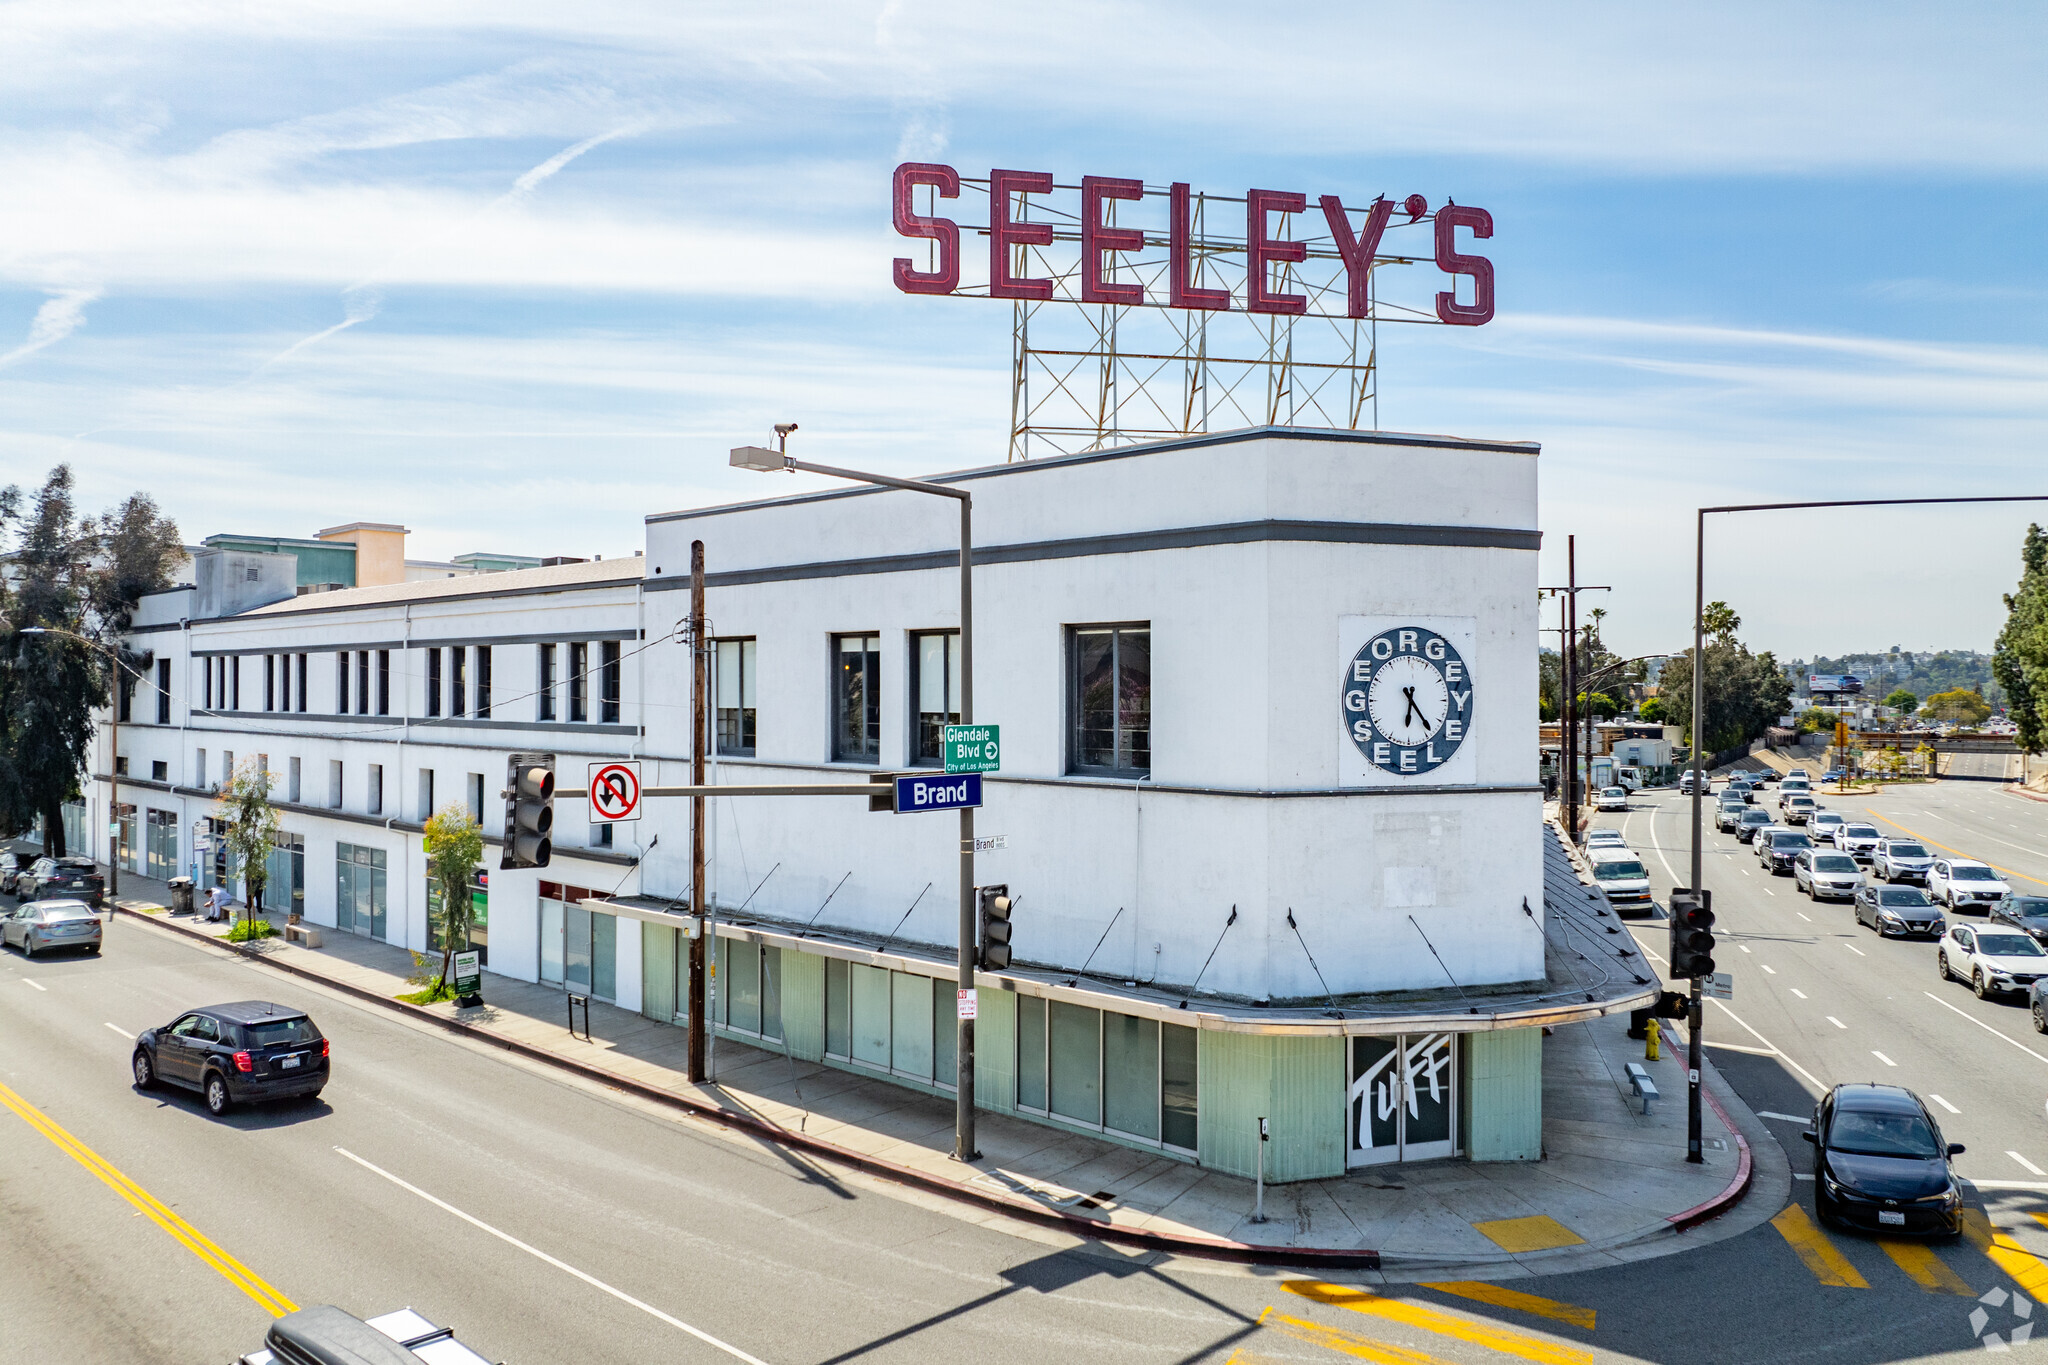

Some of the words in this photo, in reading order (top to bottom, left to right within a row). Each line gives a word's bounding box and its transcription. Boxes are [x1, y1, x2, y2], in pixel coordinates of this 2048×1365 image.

[893, 162, 1494, 326] SEELEY'S
[1345, 630, 1462, 712] GEORGE
[947, 727, 990, 742] Glendale
[1353, 690, 1471, 772] SEELEY
[957, 744, 980, 759] Blvd
[946, 763, 959, 773] City
[960, 763, 966, 771] of
[966, 762, 977, 770] Los
[978, 761, 999, 771] Angeles
[914, 780, 967, 805] Brand
[976, 838, 995, 850] Brand
[958, 990, 967, 999] NO
